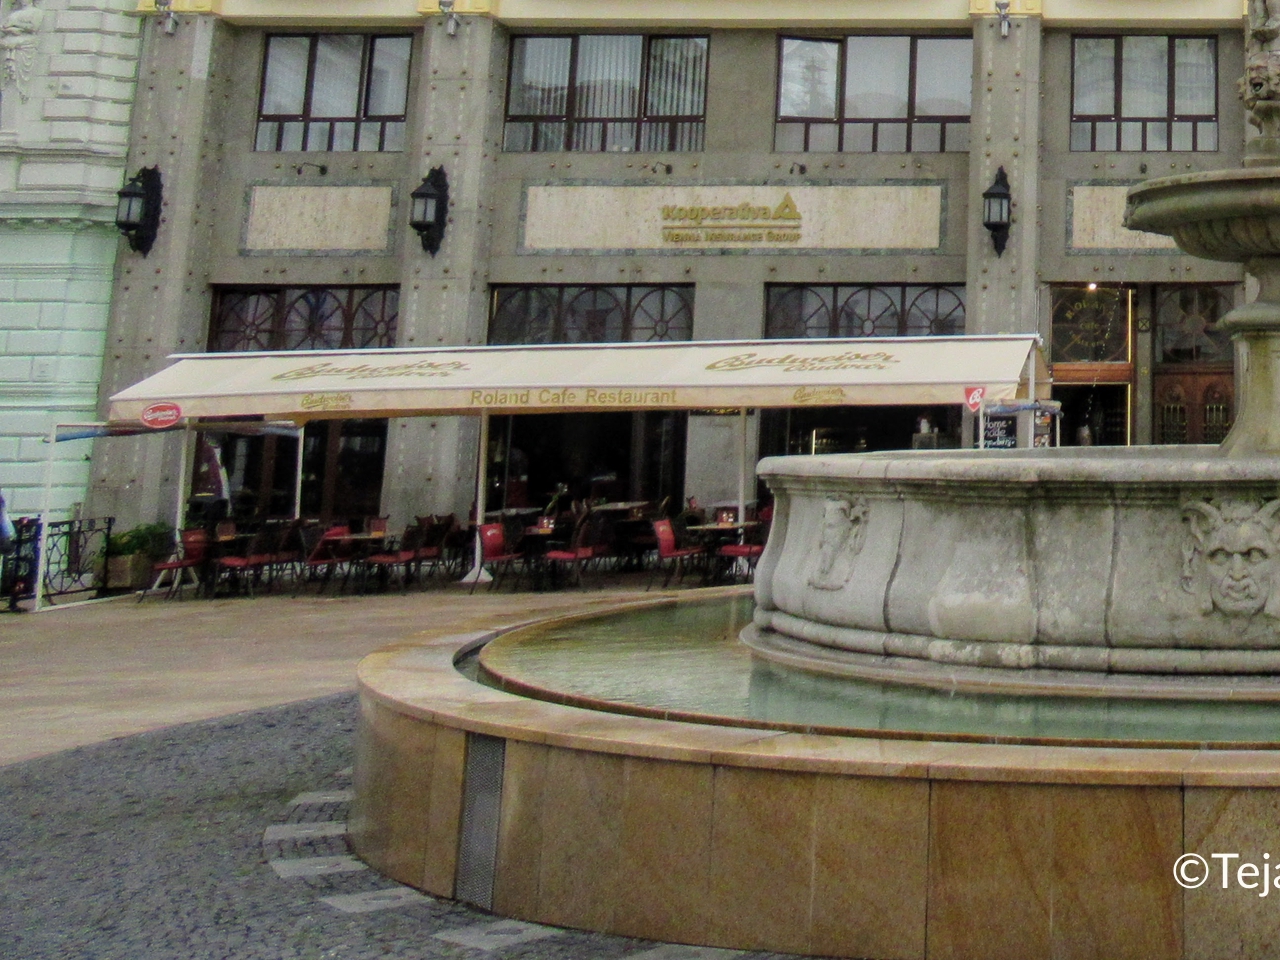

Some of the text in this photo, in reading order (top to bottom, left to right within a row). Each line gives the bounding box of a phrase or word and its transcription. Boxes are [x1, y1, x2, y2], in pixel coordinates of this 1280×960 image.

[661, 202, 771, 224] Kooperativa
[705, 351, 901, 371] Budweiser
[470, 388, 678, 406] Roland Cafe Restaurant
